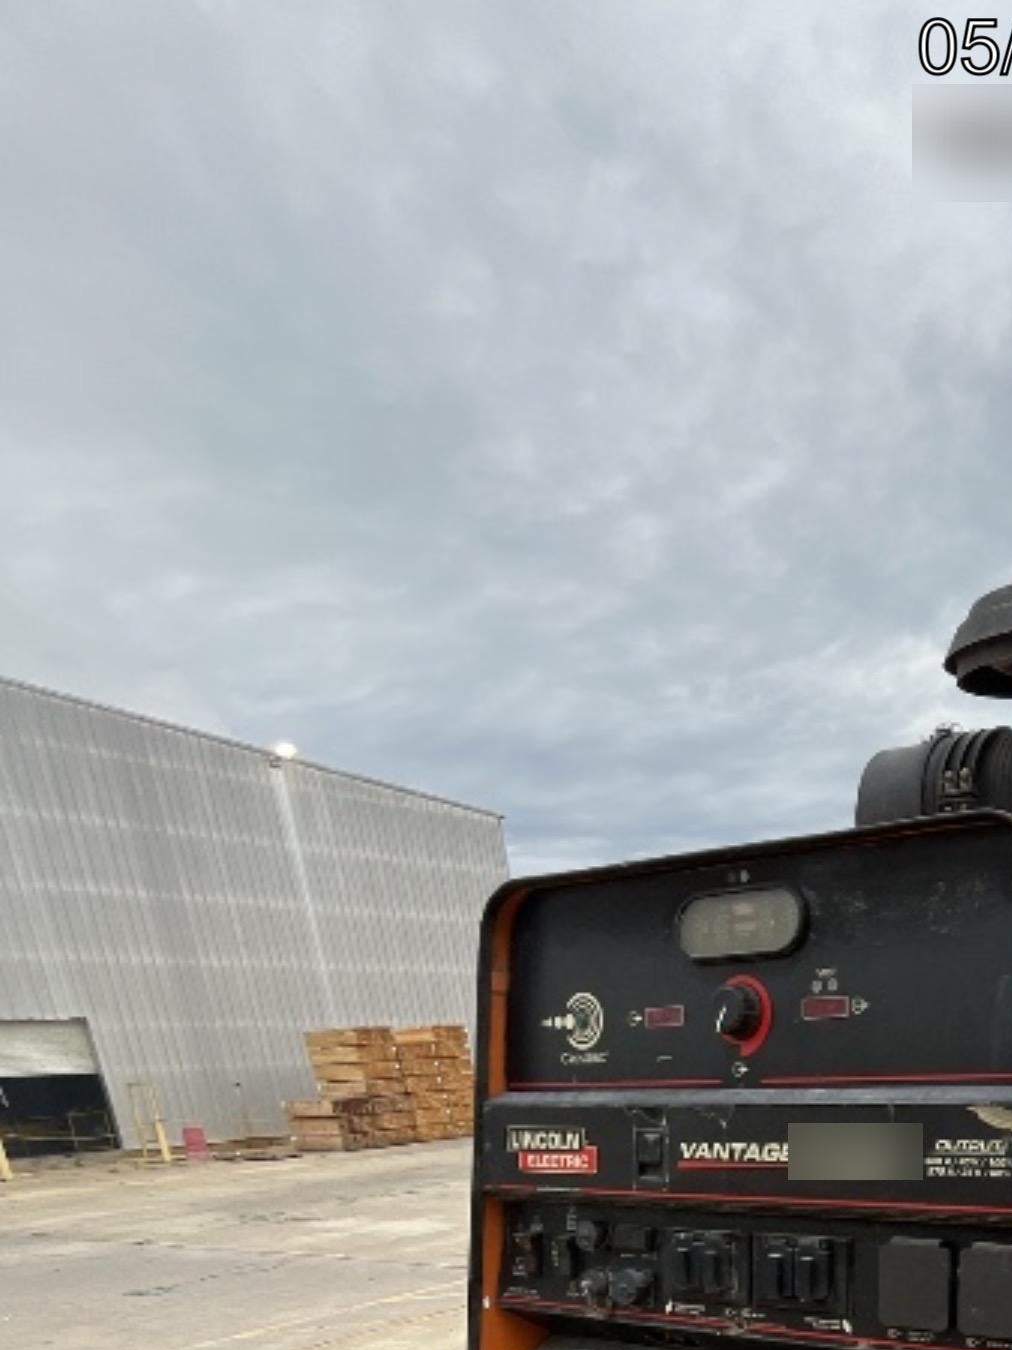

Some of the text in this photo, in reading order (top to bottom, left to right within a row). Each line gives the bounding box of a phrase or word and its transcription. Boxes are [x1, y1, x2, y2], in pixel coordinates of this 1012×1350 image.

[511, 1129, 581, 1150] LINCOLN
[526, 1153, 589, 1169] ELECTRIC
[680, 1141, 789, 1162] VANTAGE
